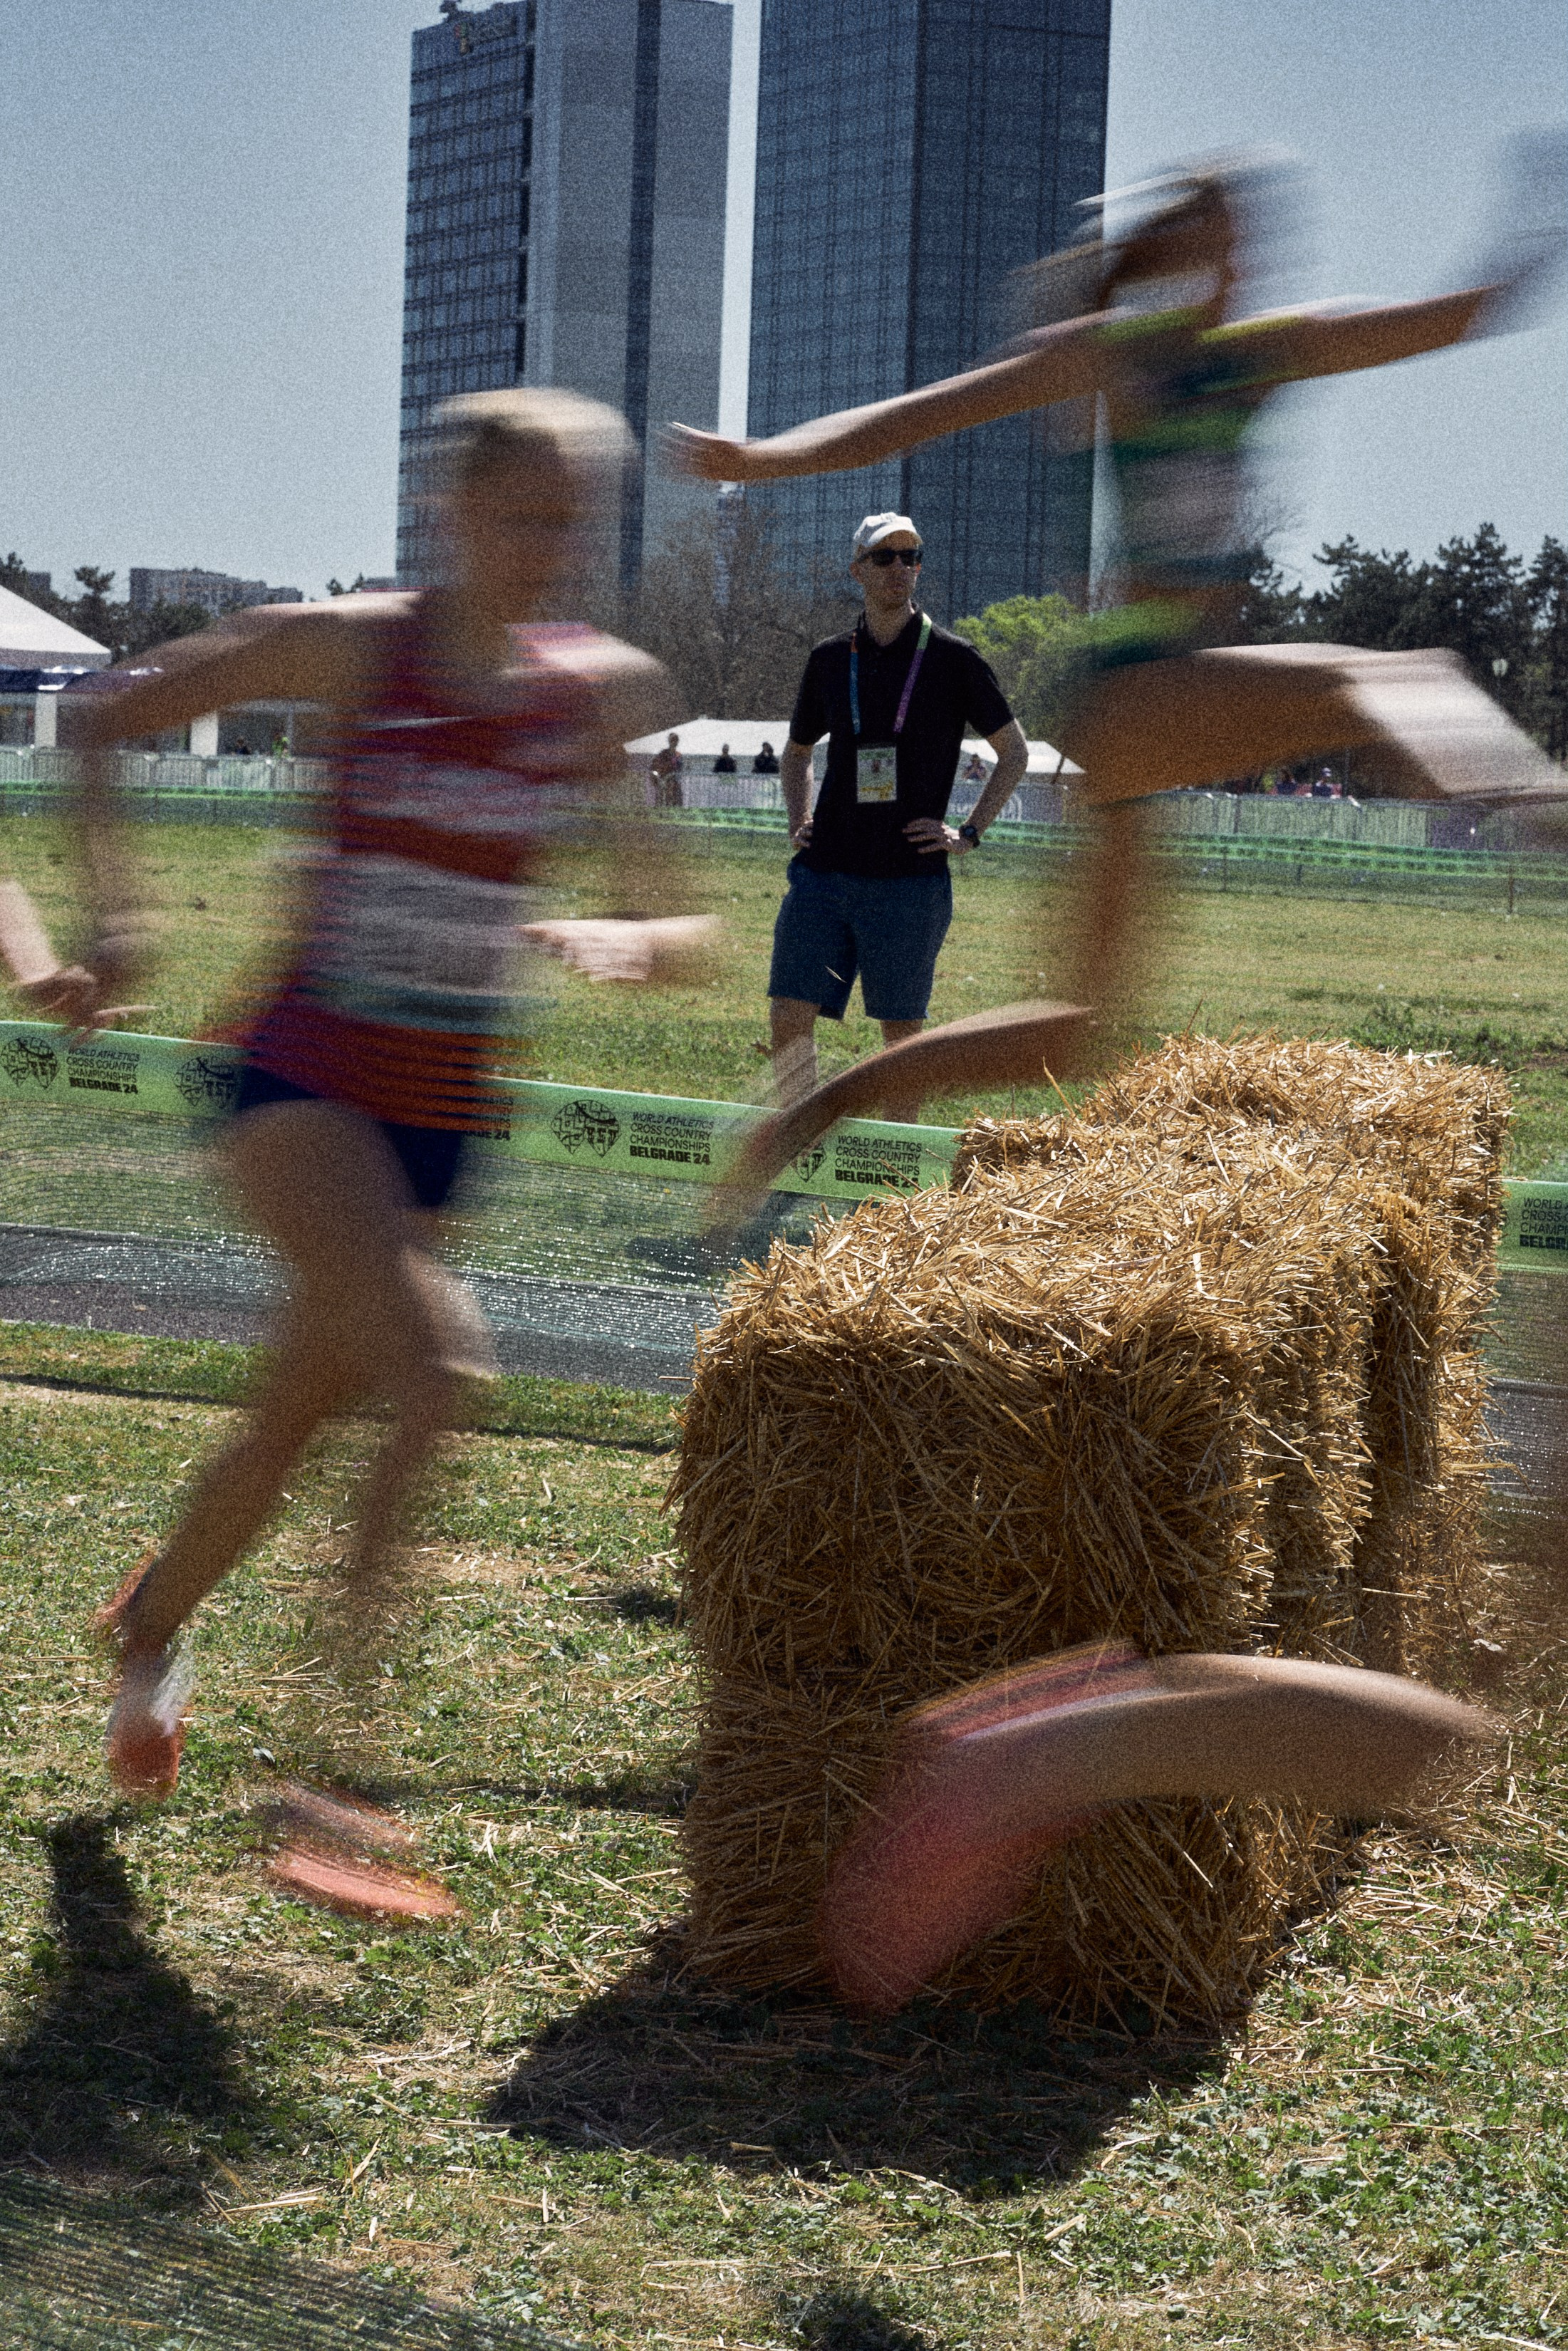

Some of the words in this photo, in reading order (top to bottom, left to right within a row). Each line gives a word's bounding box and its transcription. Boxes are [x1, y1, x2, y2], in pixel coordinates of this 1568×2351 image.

[68, 1048, 97, 1057] WORLD
[97, 1050, 140, 1062] ATHLETICS
[66, 1057, 94, 1068] CROSS
[96, 1059, 138, 1071] COUNTRY
[68, 1067, 137, 1083] CHAMPIONSHIPS
[69, 1076, 123, 1092] BELGRADE
[123, 1084, 139, 1094] 24
[633, 1111, 664, 1123] WORLD
[665, 1116, 715, 1129] ATHLETICS
[630, 1123, 663, 1135] CROSS
[664, 1126, 712, 1141] COUNTRY
[630, 1134, 711, 1153] CHAMPIONSHIPS
[838, 1136, 870, 1147] WORLD
[871, 1138, 922, 1152] ATHLETICS
[630, 1145, 692, 1163] BELGRADE
[692, 1152, 711, 1166] 24
[836, 1146, 869, 1158] CROSS
[871, 1150, 920, 1163] COUNTRY
[835, 1169, 899, 1188] BELGRADE
[1524, 1198, 1562, 1210] WORLD
[1522, 1209, 1562, 1222] CROSS
[1520, 1234, 1568, 1250] BELGR
